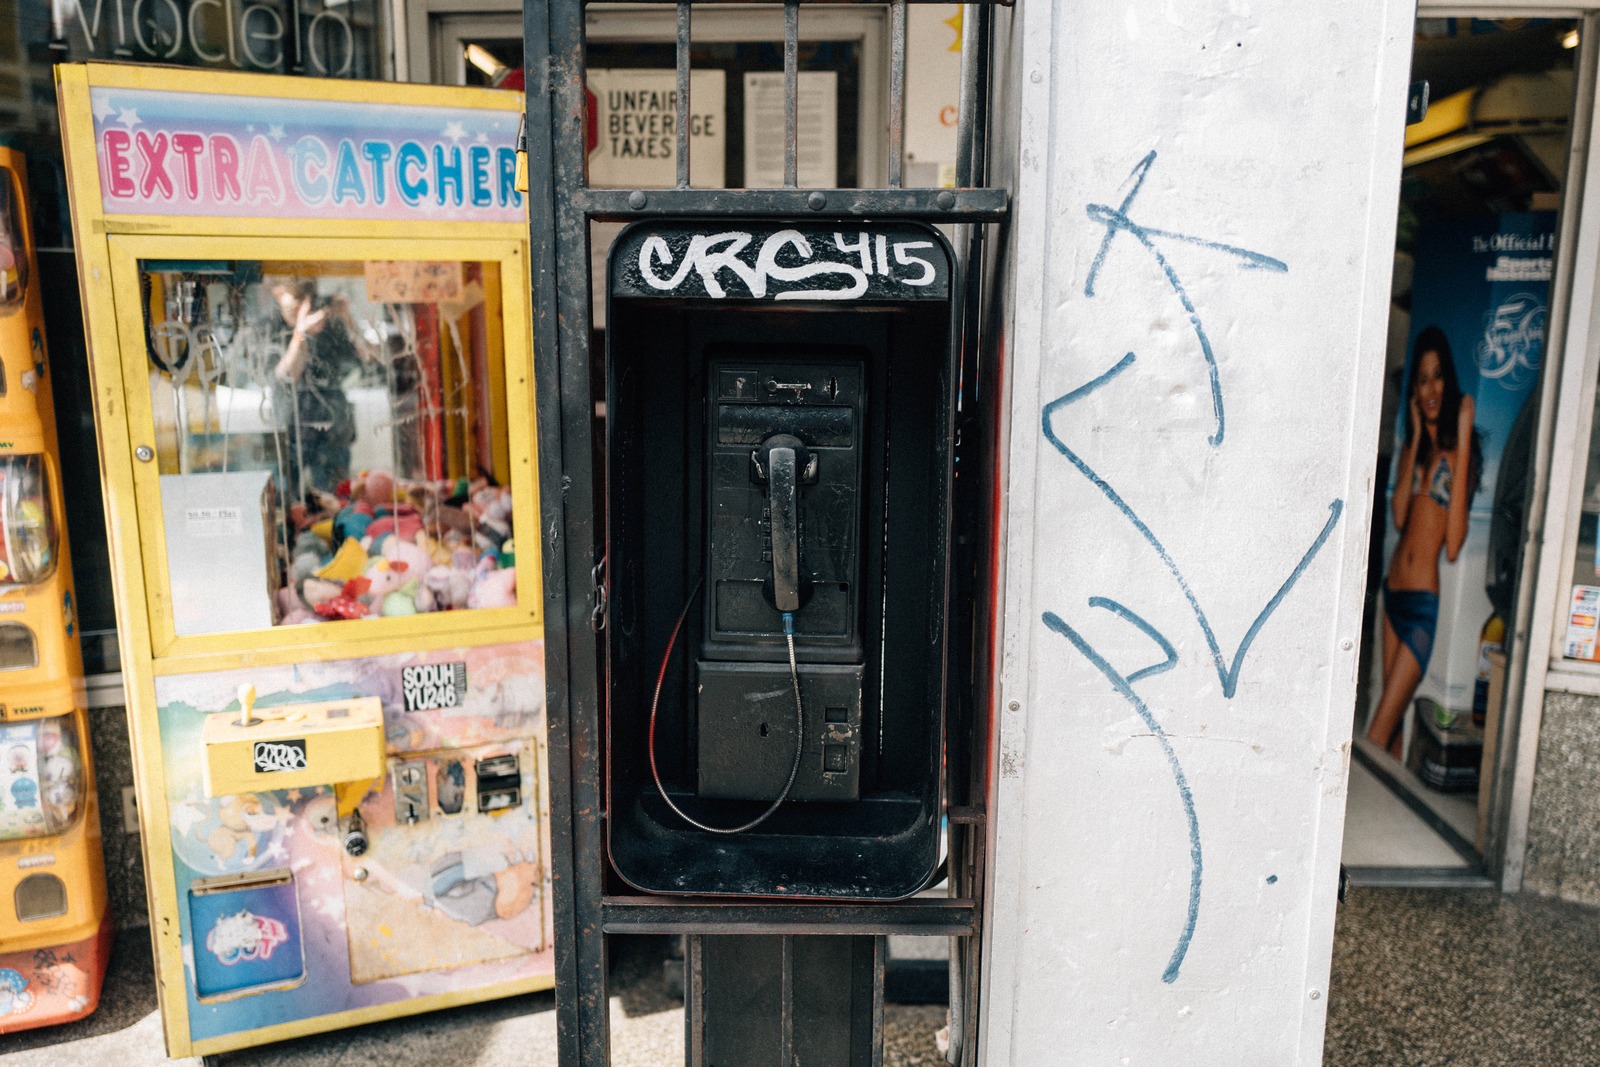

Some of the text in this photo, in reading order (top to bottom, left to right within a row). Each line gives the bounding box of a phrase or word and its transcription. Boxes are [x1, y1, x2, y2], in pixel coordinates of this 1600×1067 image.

[608, 91, 678, 112] UNFAIR
[608, 114, 716, 137] BEVERGE
[610, 137, 672, 159] TAXES
[102, 129, 522, 208] EXTRA CATCHER
[1490, 232, 1545, 251] Official
[403, 662, 455, 690] SODUH
[404, 684, 457, 711] YU246
[12, 706, 44, 714] TOMY
